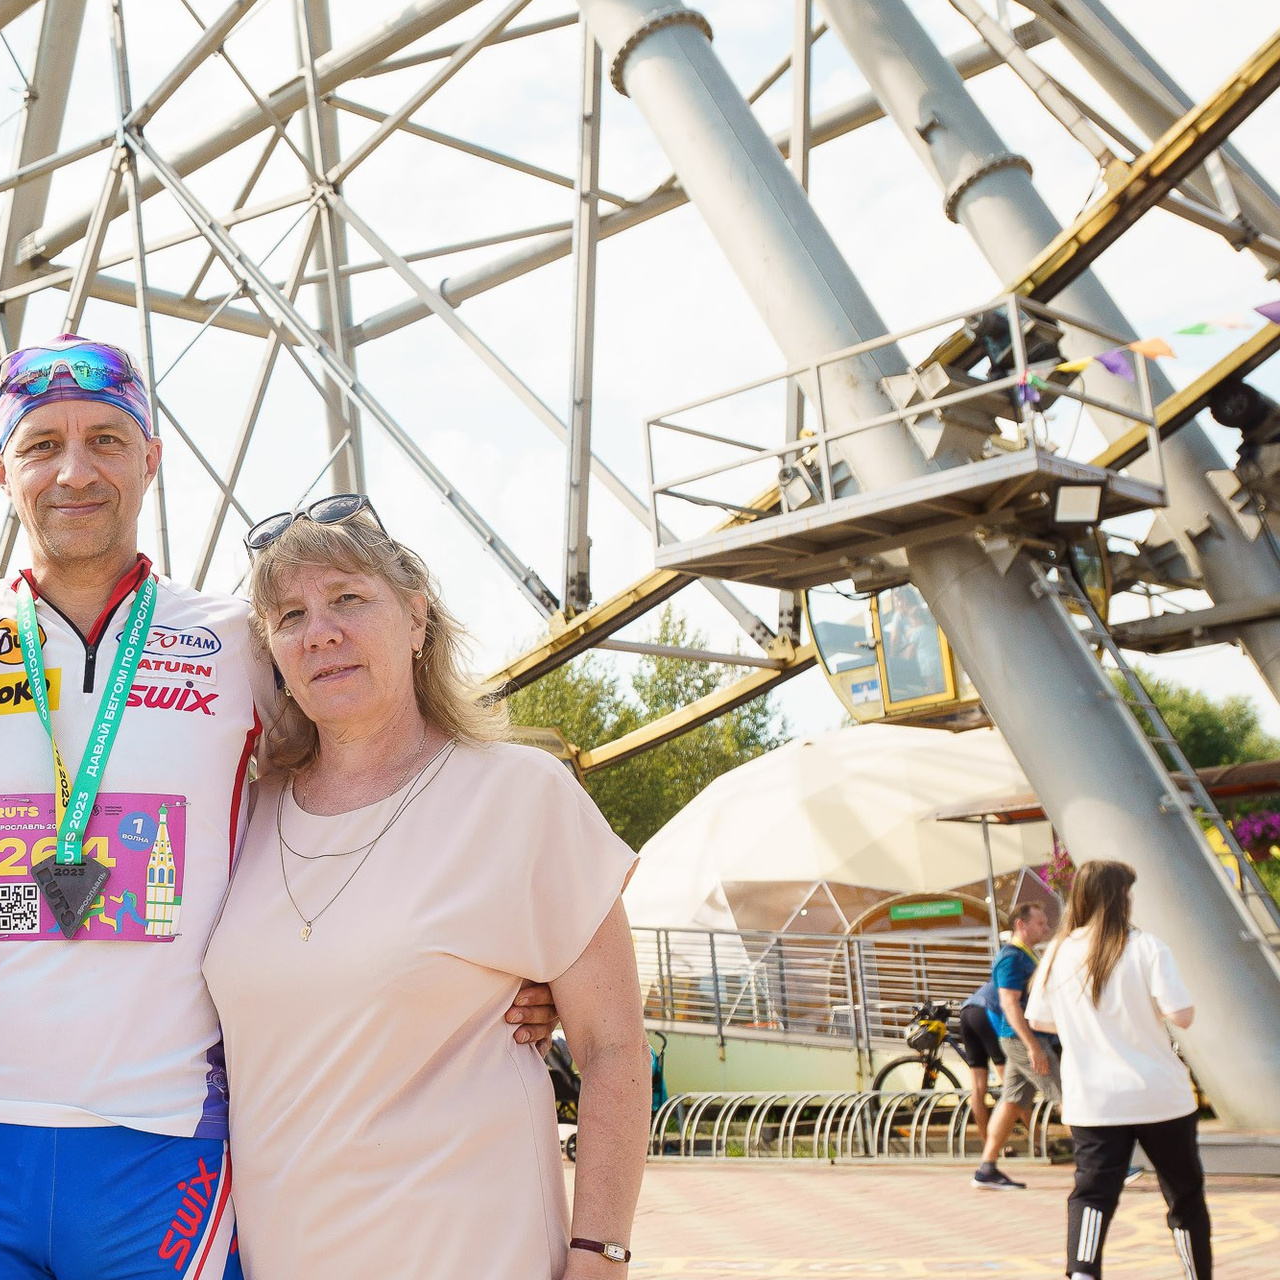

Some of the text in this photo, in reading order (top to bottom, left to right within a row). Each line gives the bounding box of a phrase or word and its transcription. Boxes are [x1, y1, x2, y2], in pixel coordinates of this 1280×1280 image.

[179, 634, 216, 650] TEAM
[23, 631, 48, 721] ЯРОСЛАВЛЮ
[137, 659, 212, 677] ATURN
[64, 832, 75, 866] UTS
[70, 791, 89, 830] 2023
[86, 722, 111, 777] ДАВАЙ
[104, 670, 128, 723] БЕГОМ
[121, 647, 135, 667] ПО
[132, 818, 144, 834] 1
[122, 833, 149, 844] ВОЛНА
[54, 868, 85, 877] 2023
[77, 872, 106, 915] ЯРОСЛАВЛЬ
